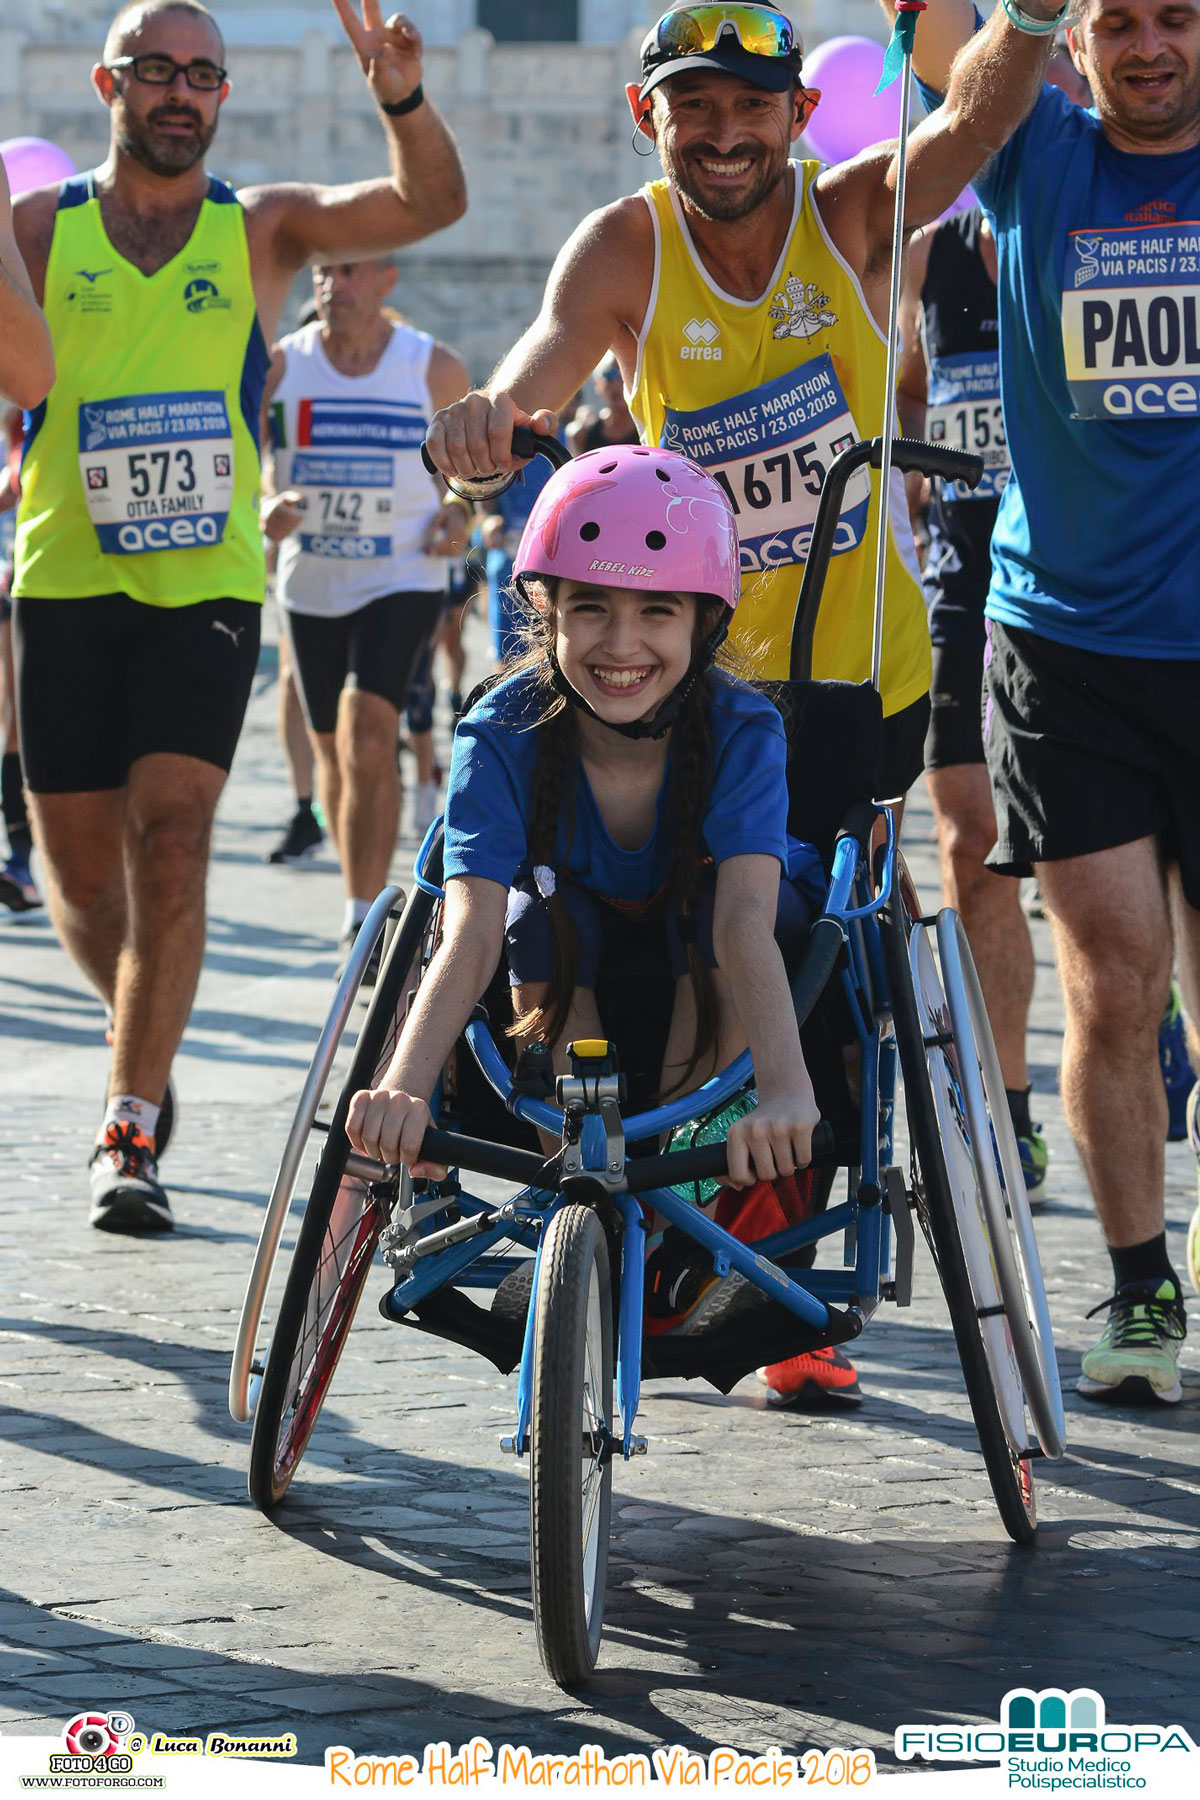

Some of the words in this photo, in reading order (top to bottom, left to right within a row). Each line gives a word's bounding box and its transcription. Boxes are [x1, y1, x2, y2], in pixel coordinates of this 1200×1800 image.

[1101, 240, 1138, 257] ROME
[1141, 238, 1174, 254] HALF
[1101, 259, 1124, 276] VIA
[1127, 257, 1168, 275] PACIS
[1179, 256, 1200, 273] 23.
[1082, 295, 1200, 369] PAOL
[680, 345, 722, 361] errea
[105, 406, 138, 424] ROME
[138, 403, 166, 420] HALF
[167, 401, 224, 417] MARATHON
[681, 419, 723, 442] ROME
[723, 406, 759, 431] HALF
[760, 370, 832, 418] MARATHON
[107, 424, 128, 440] VIA
[128, 420, 163, 437] PACIS
[170, 415, 228, 433] 23.09.2018
[687, 440, 716, 459] VIA
[716, 427, 759, 452] PACIS
[768, 390, 838, 436] 23.09.2018
[128, 448, 197, 498] 573
[712, 441, 827, 515] 1675
[127, 500, 160, 518] OTTA
[161, 494, 205, 515] FAMILY
[319, 491, 363, 521] 742
[118, 516, 217, 551] acea
[310, 533, 377, 558] acea
[588, 559, 626, 575] REBEL
